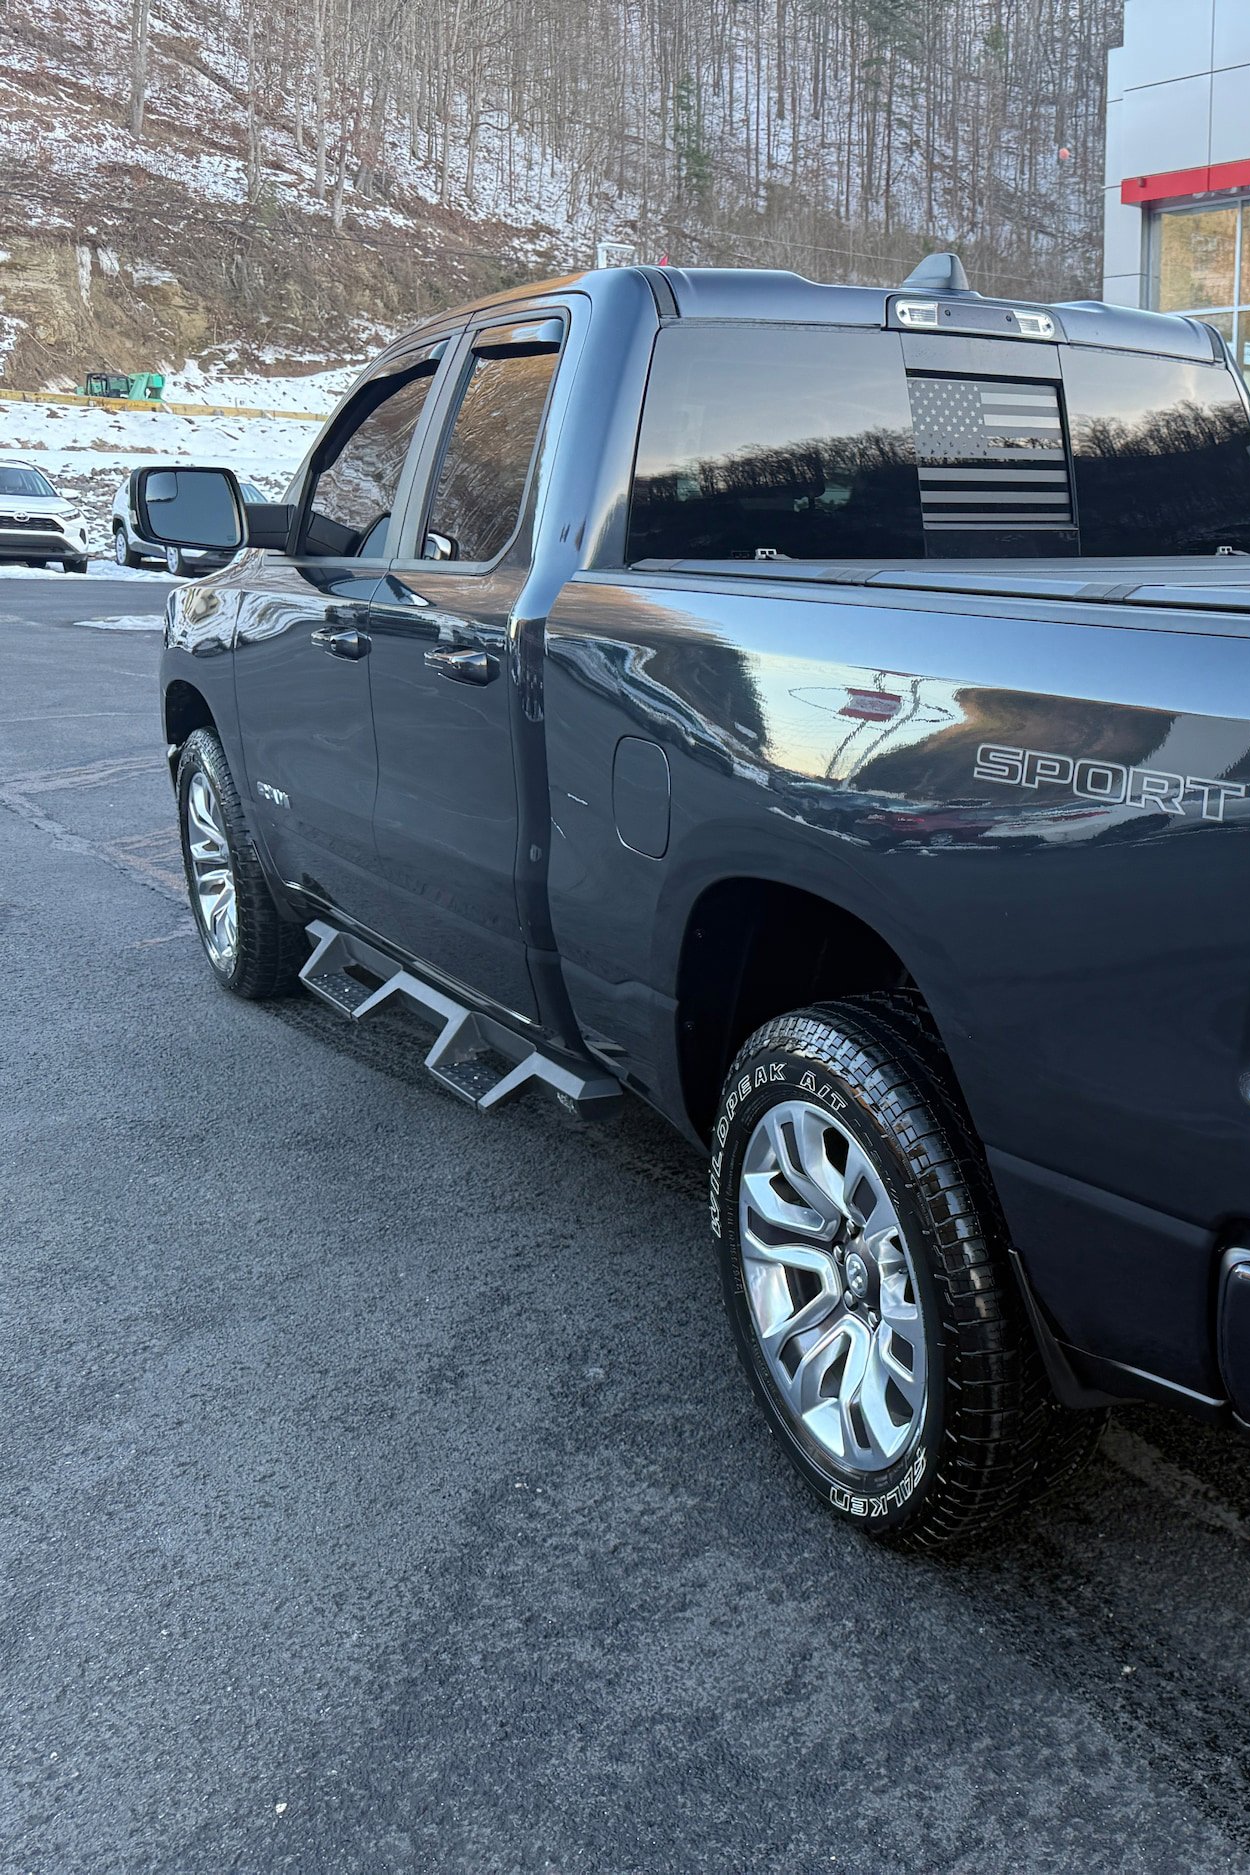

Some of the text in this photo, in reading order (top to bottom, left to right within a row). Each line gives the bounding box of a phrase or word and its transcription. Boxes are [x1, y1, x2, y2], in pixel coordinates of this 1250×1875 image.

[973, 742, 1246, 822] SPORT
[709, 1062, 788, 1239] WILDPEAK
[829, 1446, 928, 1518] FALKEN
